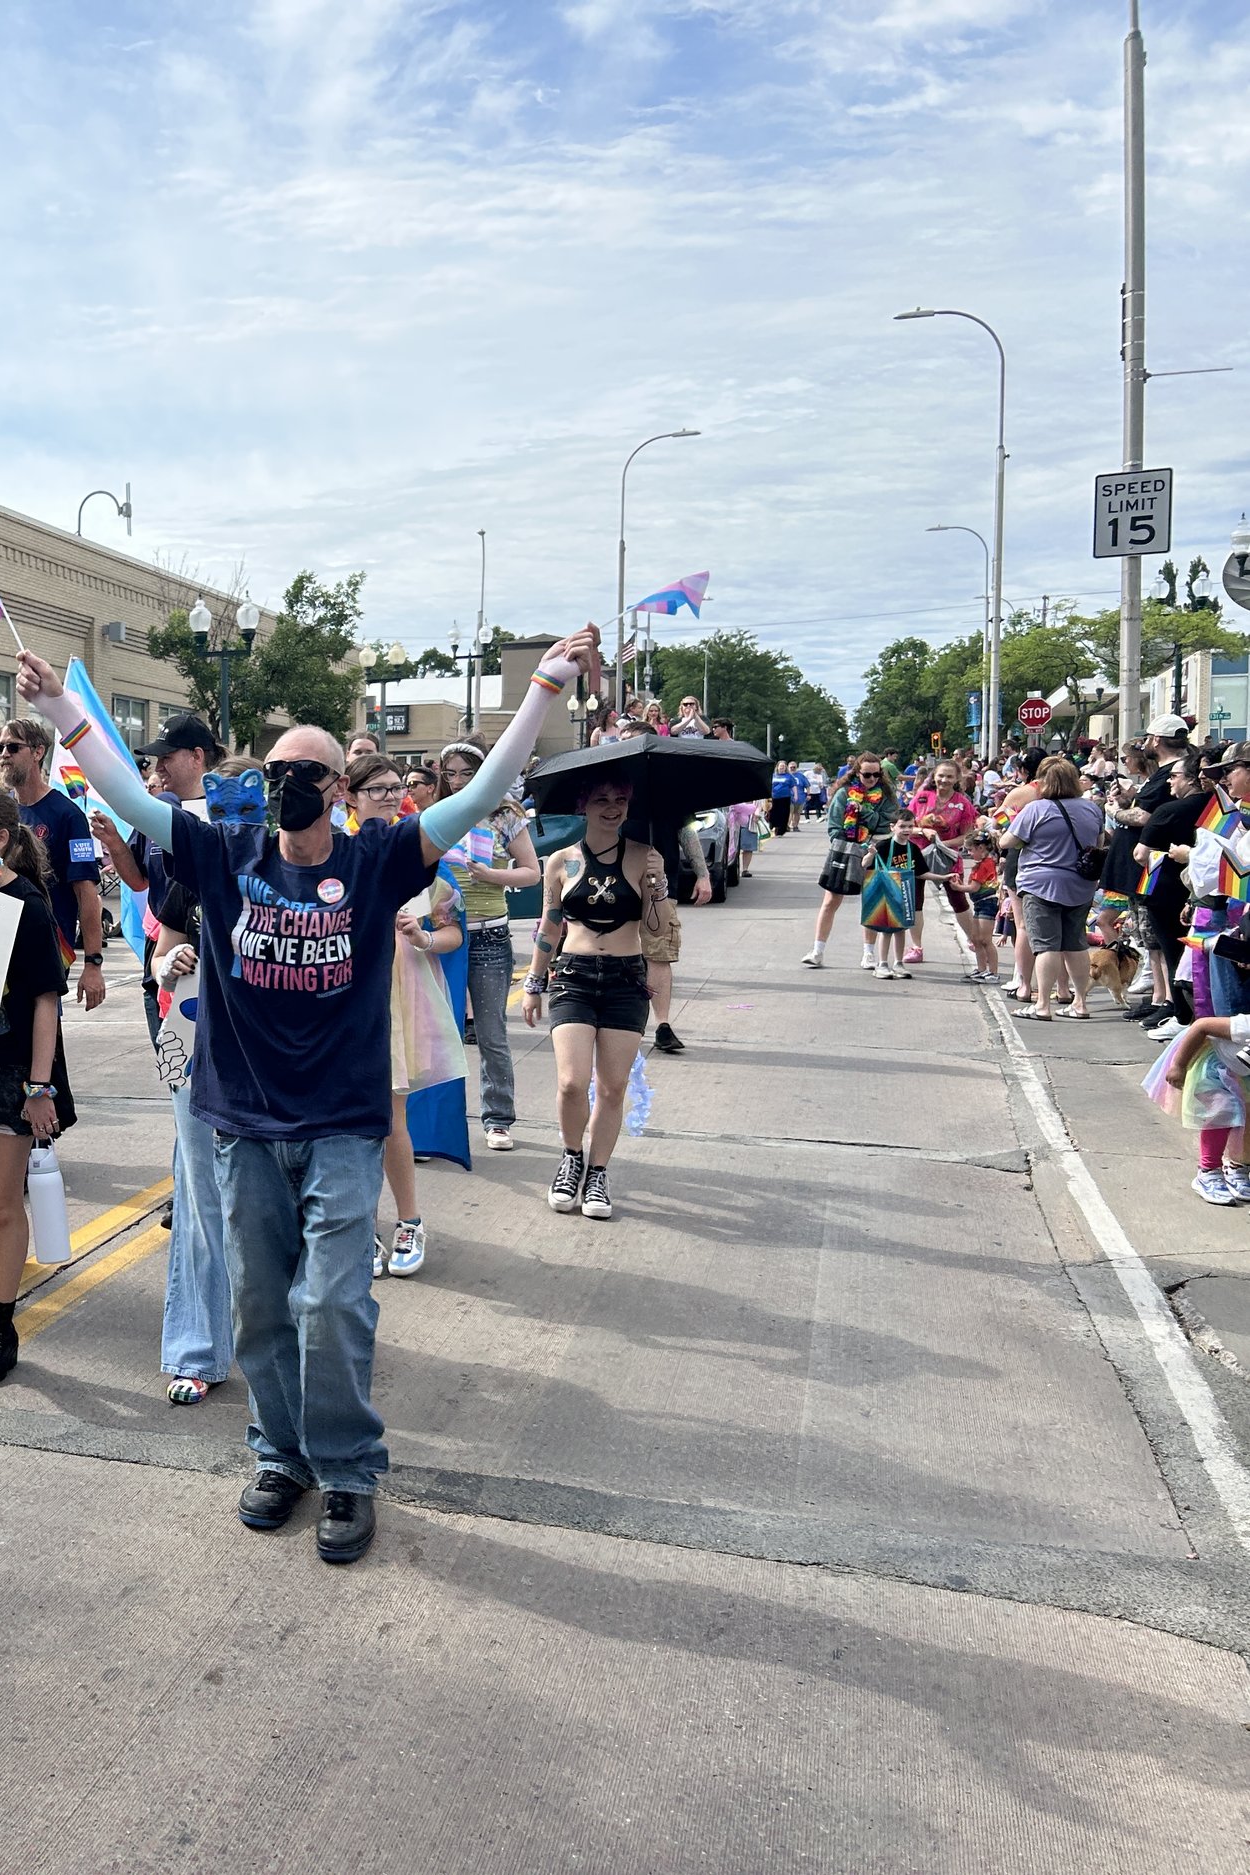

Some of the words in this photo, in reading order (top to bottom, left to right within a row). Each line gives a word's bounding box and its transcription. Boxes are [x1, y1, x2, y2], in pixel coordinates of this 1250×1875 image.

[1102, 479, 1166, 497] SPEED
[1108, 497, 1158, 513] LIMIT
[1108, 514, 1156, 547] 15
[1021, 707, 1050, 719] STOP
[249, 876, 274, 904] WE
[250, 905, 278, 934] THE
[280, 908, 353, 938] CHANGE
[241, 930, 299, 965] WE'VE
[301, 934, 352, 965] BEEN
[241, 956, 318, 992] WAITING
[323, 958, 353, 990] FOR
